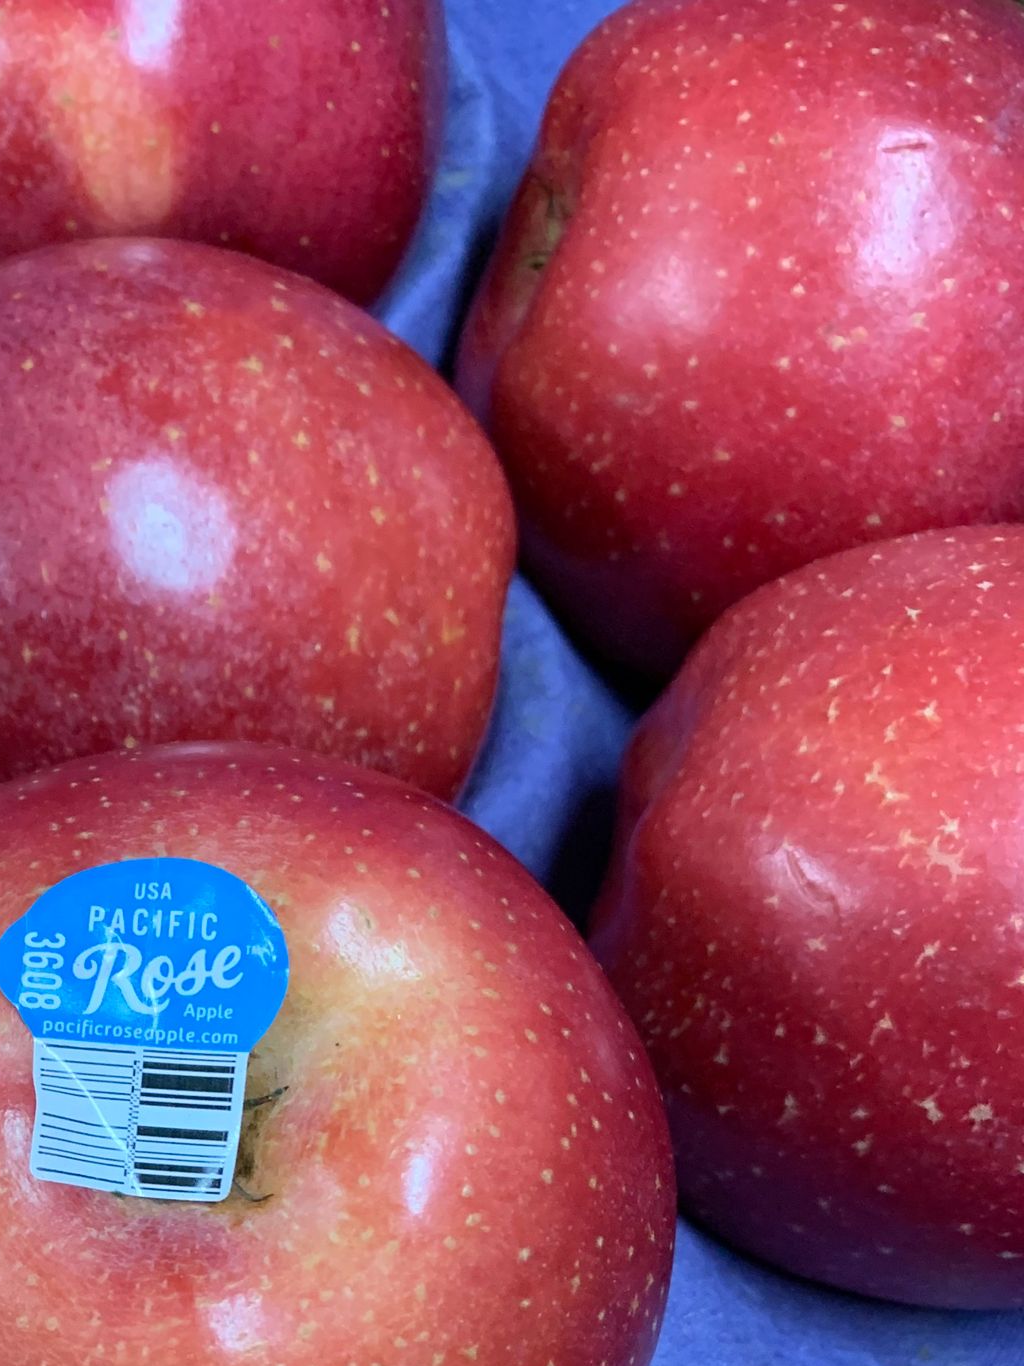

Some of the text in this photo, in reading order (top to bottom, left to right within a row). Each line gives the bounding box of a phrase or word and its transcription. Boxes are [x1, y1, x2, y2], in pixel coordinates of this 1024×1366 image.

[134, 882, 173, 900] USA
[88, 906, 218, 940] PACIFIC
[19, 932, 66, 1010] 3608
[73, 943, 244, 1015] Rose
[184, 1004, 233, 1022] Apple
[42, 1019, 238, 1045] pacificroseapple.com
